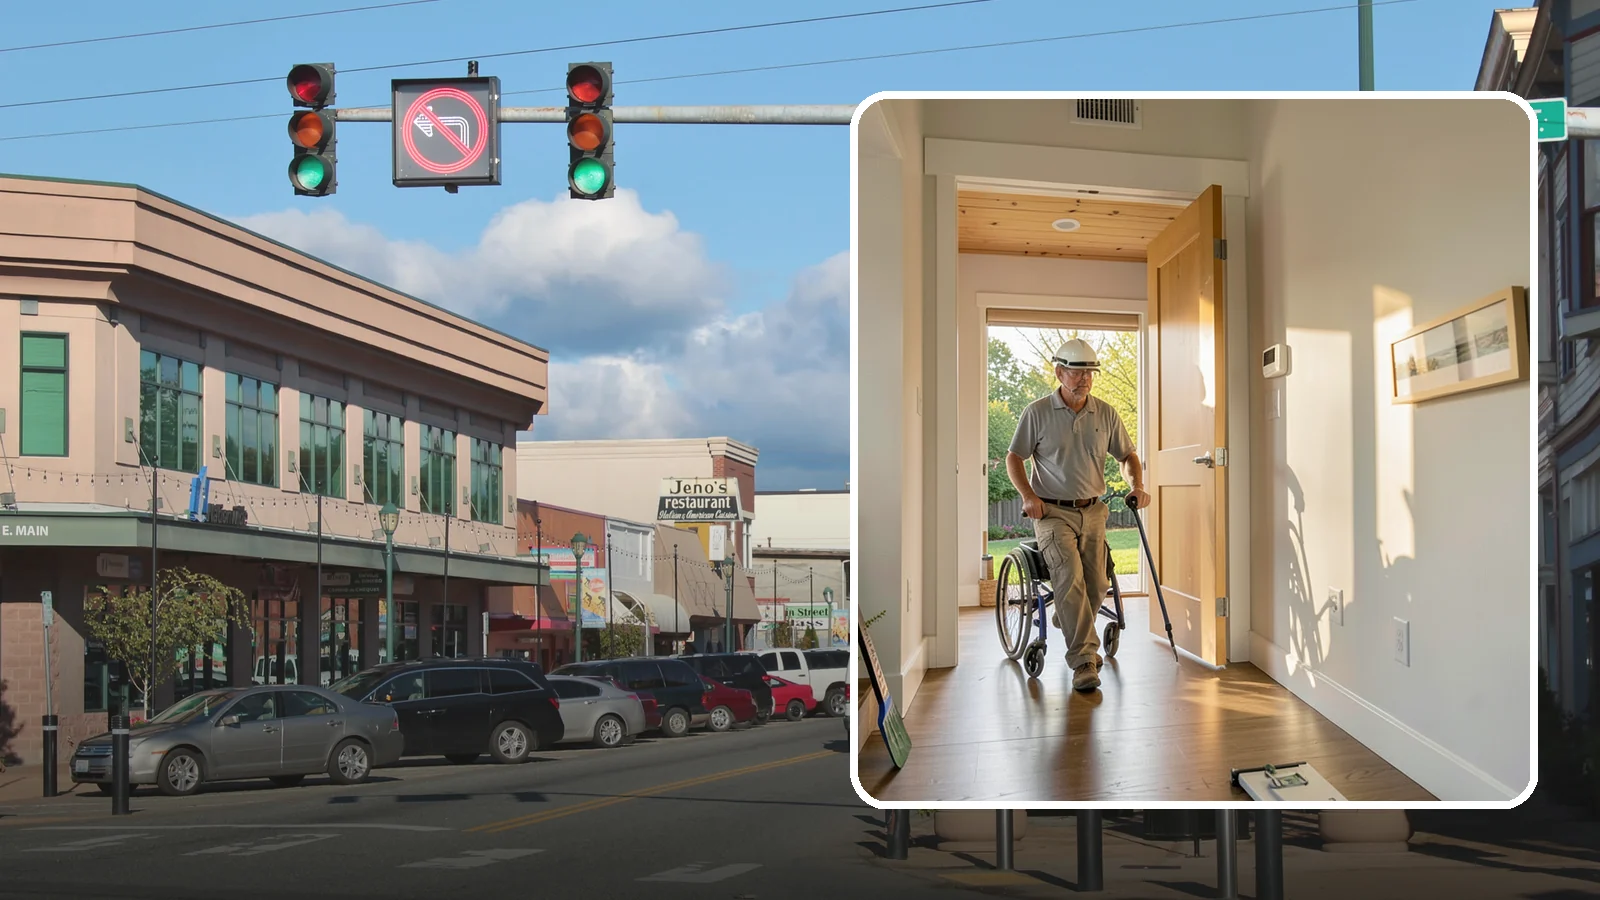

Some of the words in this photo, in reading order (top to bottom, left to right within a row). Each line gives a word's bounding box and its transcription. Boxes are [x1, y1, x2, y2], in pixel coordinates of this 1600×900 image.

[669, 480, 728, 495] Jeno's
[665, 496, 731, 509] restaurant
[658, 509, 681, 520] Italian
[685, 509, 714, 520] American
[714, 509, 738, 519] Cuisine
[2, 525, 13, 536] E.
[15, 525, 49, 536] MAIN
[797, 607, 828, 617] Street
